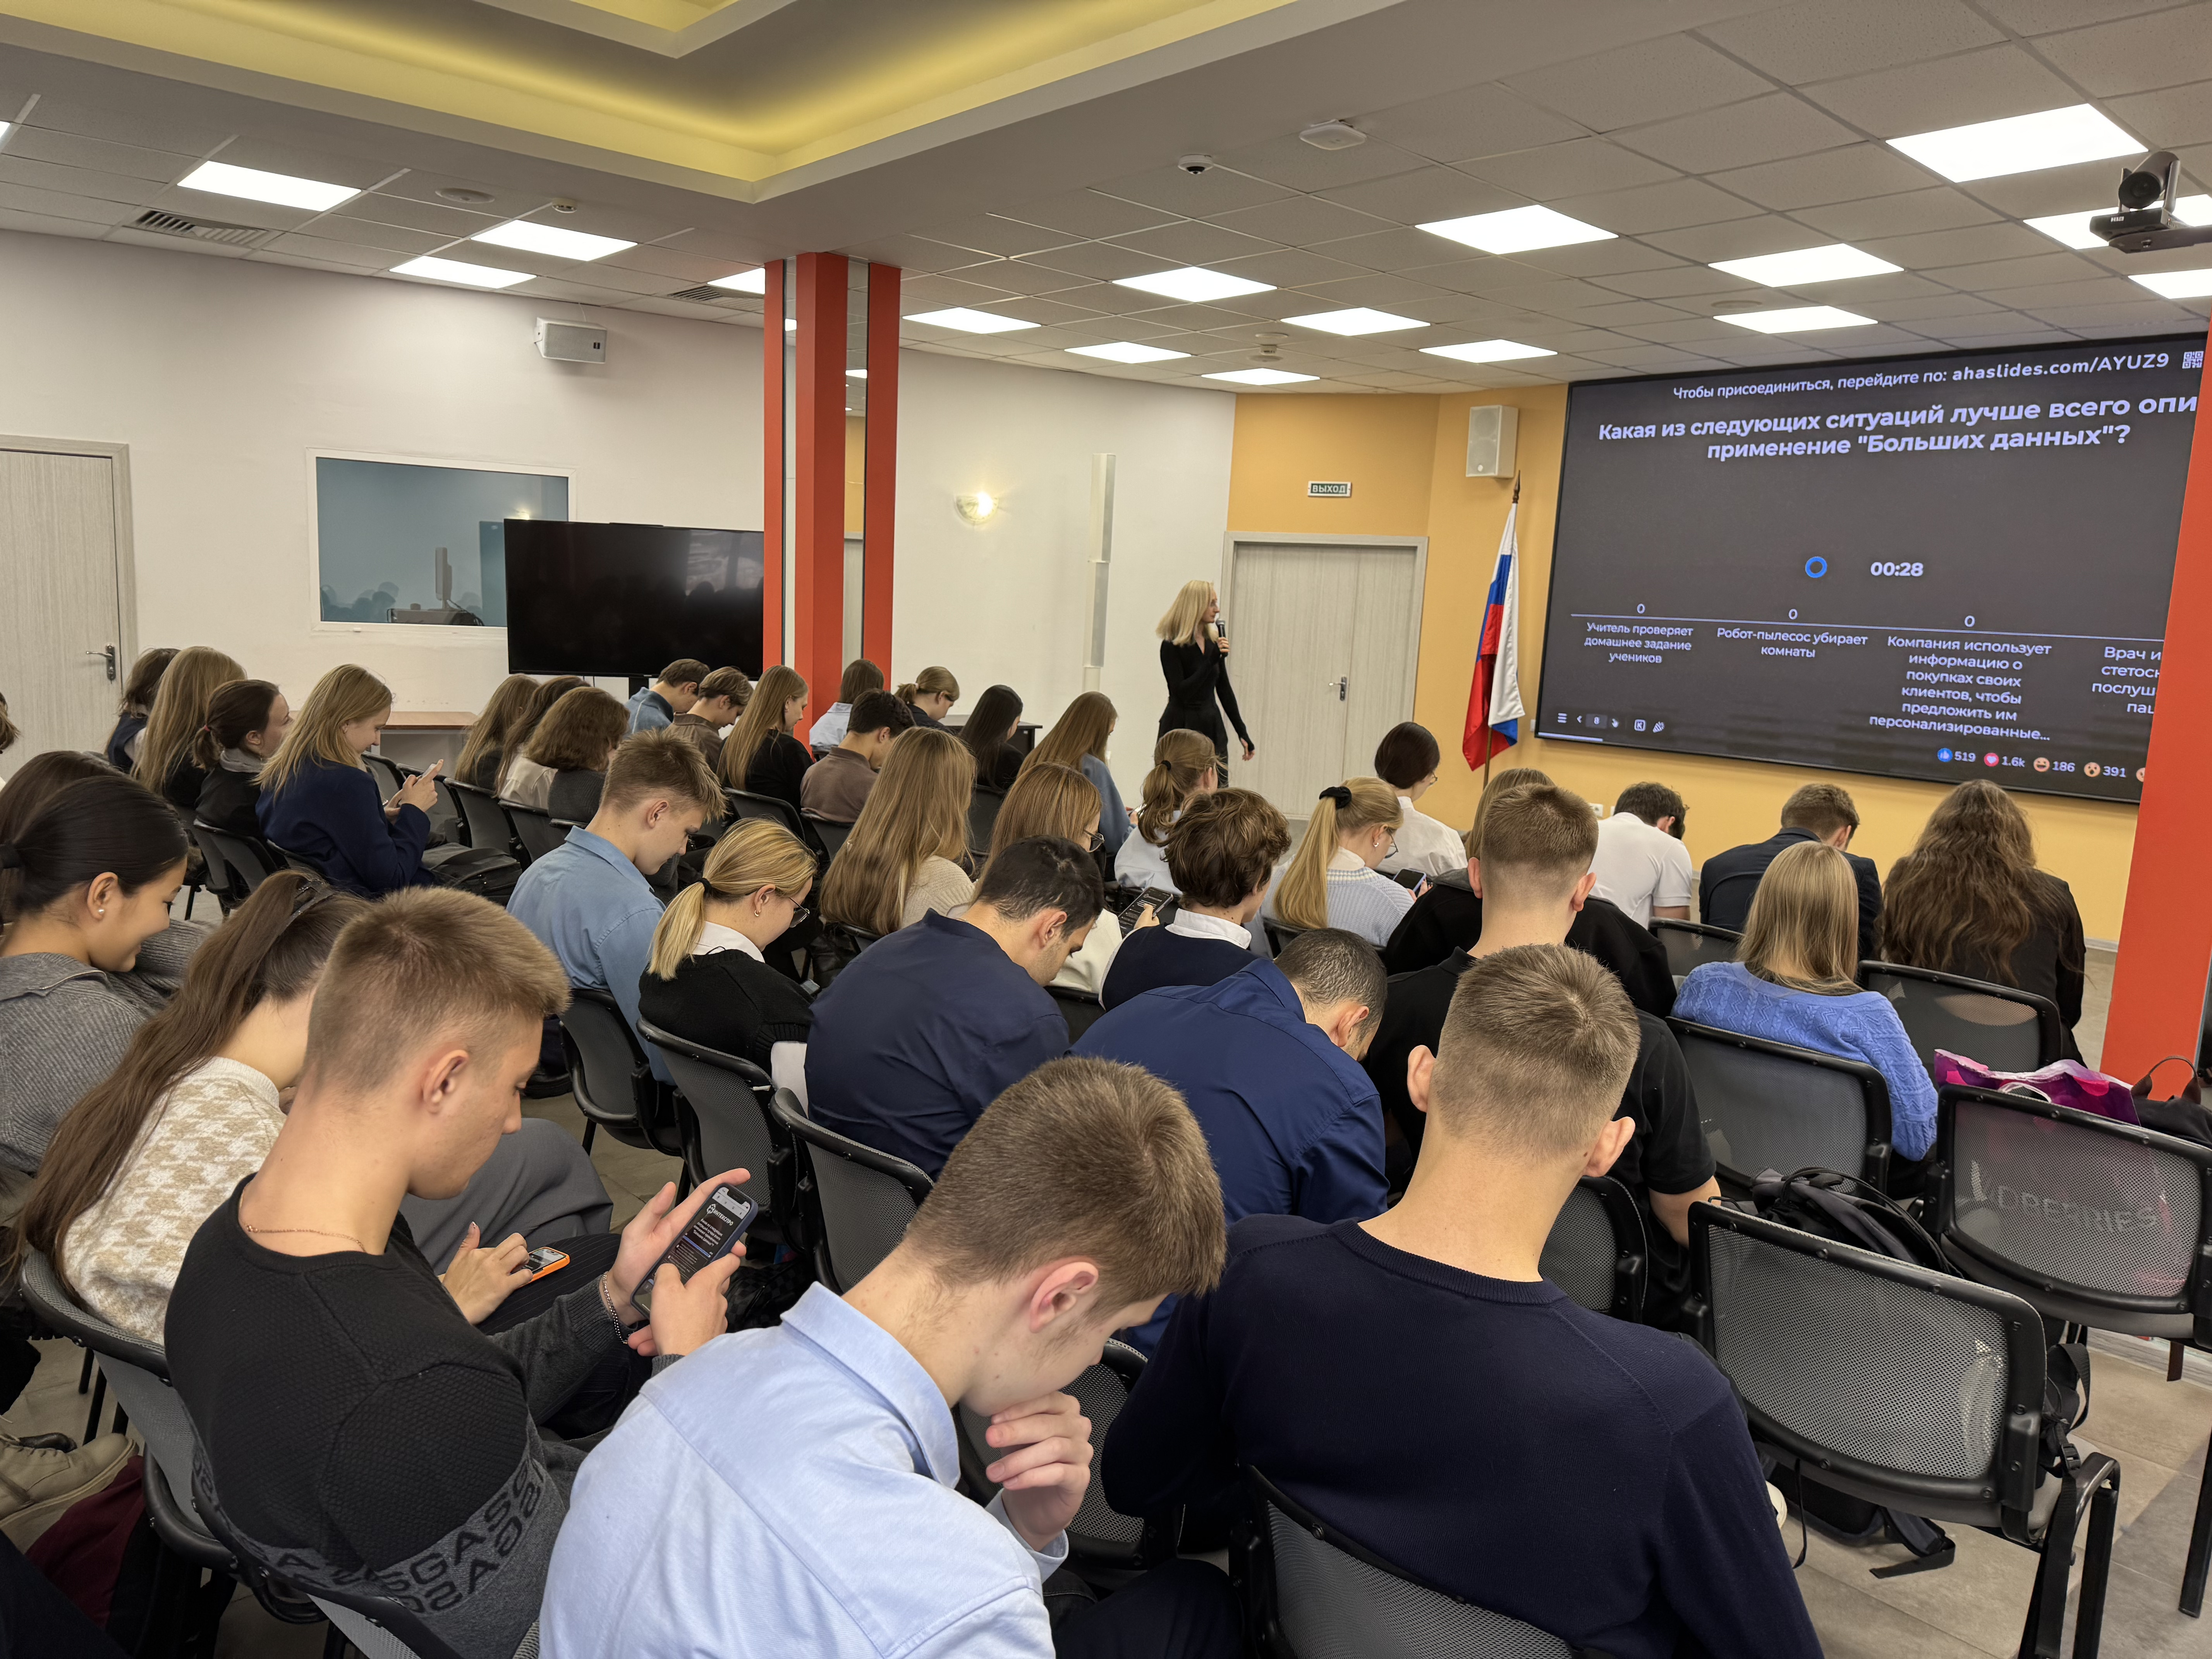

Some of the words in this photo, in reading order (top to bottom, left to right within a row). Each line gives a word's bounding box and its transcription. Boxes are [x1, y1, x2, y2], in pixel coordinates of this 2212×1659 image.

[1673, 386, 1714, 399] Чтобы
[1717, 380, 1833, 398] присоединиться,
[1838, 373, 1919, 389] перейдите
[1923, 371, 1947, 383] по:
[1952, 353, 2169, 381] ahaslides.com/AYUZ9
[1599, 424, 1656, 440] Какая
[1662, 423, 1685, 437] из
[1690, 416, 1821, 437] следующих
[1826, 404, 1944, 431] ситуаций
[1950, 404, 2041, 426] лучше
[2049, 400, 2130, 418] всего
[2138, 396, 2197, 414] опи
[1707, 438, 1851, 461] применение
[1858, 434, 1985, 452] "Больших
[1990, 424, 2130, 451] данных"?
[1312, 484, 1345, 493] ВЫХОД
[1870, 562, 1923, 577] 00:28
[1587, 622, 1630, 633] Учитель
[1632, 625, 1693, 637] проверяет
[1717, 628, 1811, 642] Робот-пылесос
[1812, 632, 1868, 646] убирает
[1584, 637, 1642, 648] домашнее
[1644, 640, 1692, 651] задание
[1887, 636, 1960, 650] Компания
[1964, 642, 2052, 656] использует
[1608, 653, 1662, 663] учеников
[1761, 646, 1815, 658] комнаты
[2104, 646, 2146, 661] Врач
[1909, 654, 2009, 670] информацию
[2013, 661, 2023, 670] о
[1906, 671, 1973, 684] покупках
[1976, 676, 2021, 687] своих
[1901, 687, 1972, 702] клиентов,
[1975, 691, 2021, 704] чтобы
[2092, 683, 2156, 697] послуш
[1902, 703, 1992, 719] предложить
[1996, 711, 2017, 721] им
[1869, 715, 2050, 740] персонализированные...
[1954, 751, 1976, 762] 519
[2002, 756, 2025, 767] 1.6k
[2052, 761, 2075, 772] 186
[2103, 766, 2126, 778] 391
